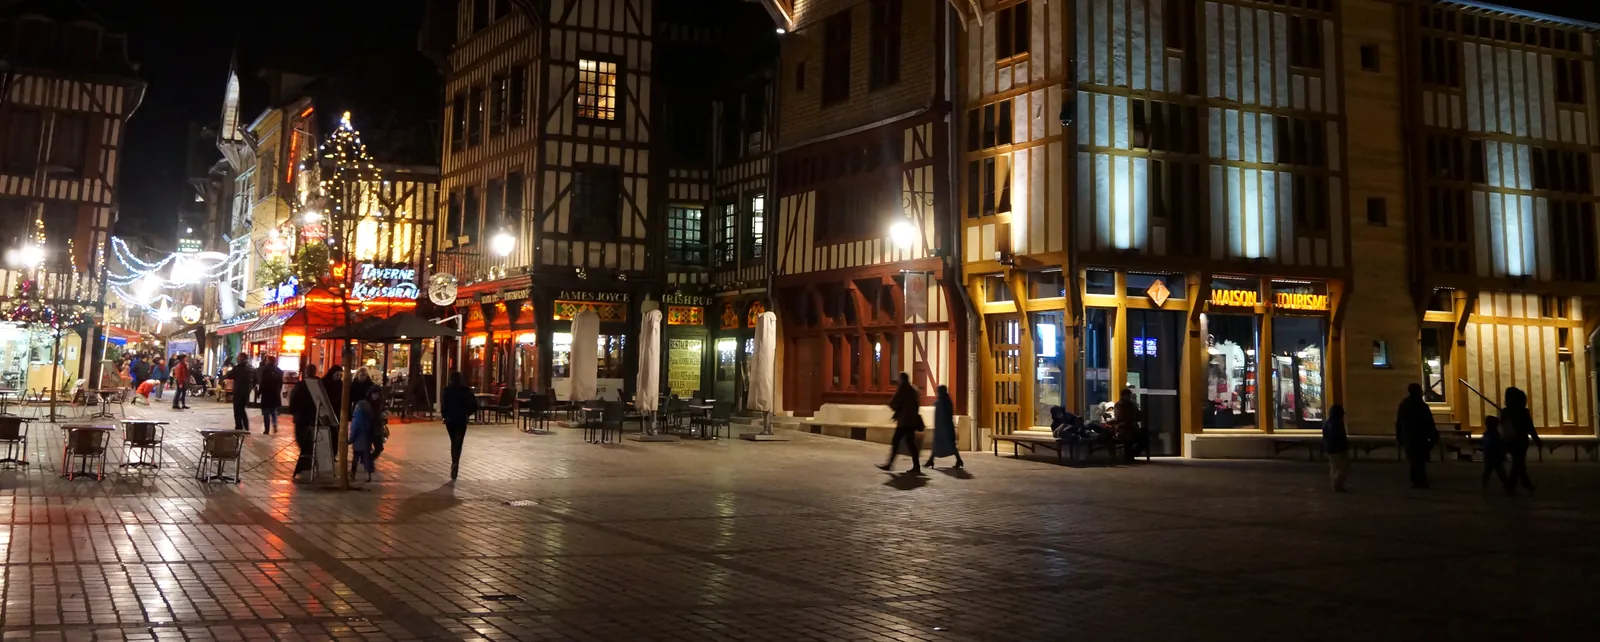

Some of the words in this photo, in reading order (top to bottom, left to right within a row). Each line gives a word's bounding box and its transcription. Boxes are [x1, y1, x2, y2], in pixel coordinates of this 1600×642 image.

[361, 264, 415, 280] TAVERNE
[558, 290, 595, 301] JAMES
[595, 291, 630, 302] JOYCE
[662, 293, 692, 305] IRISH
[692, 295, 713, 306] PUB
[1212, 289, 1256, 306] MAISON
[1277, 293, 1328, 310] TOURISME
